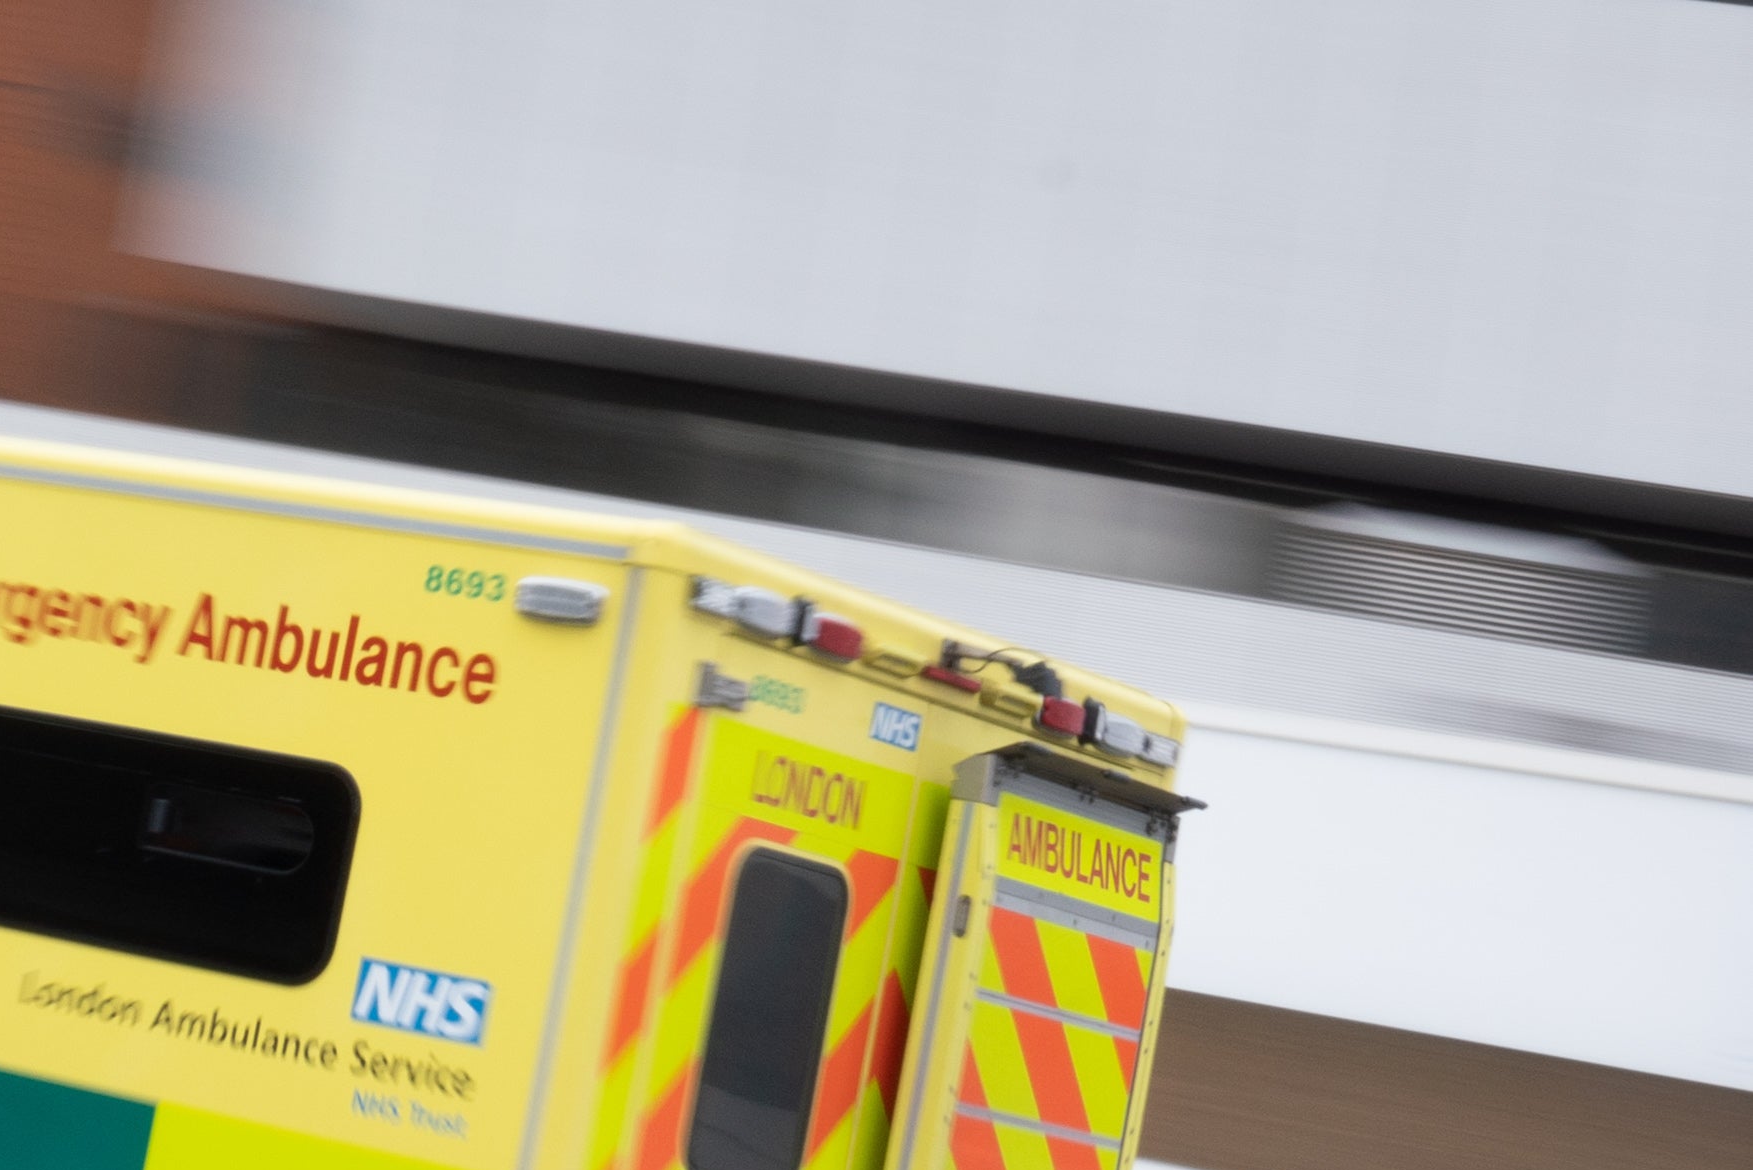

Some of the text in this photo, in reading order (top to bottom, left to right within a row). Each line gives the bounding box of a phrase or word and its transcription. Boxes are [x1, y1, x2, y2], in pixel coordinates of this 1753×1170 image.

[424, 564, 506, 602] 8693
[176, 591, 497, 706] Ambulance
[870, 704, 921, 749] NHS
[752, 749, 865, 830] LONDON
[1007, 812, 1152, 903] AMBULANCE
[18, 970, 477, 1101] London Ambulance Service
[352, 960, 489, 1043] NHS
[351, 1087, 469, 1141] NHS Trust
